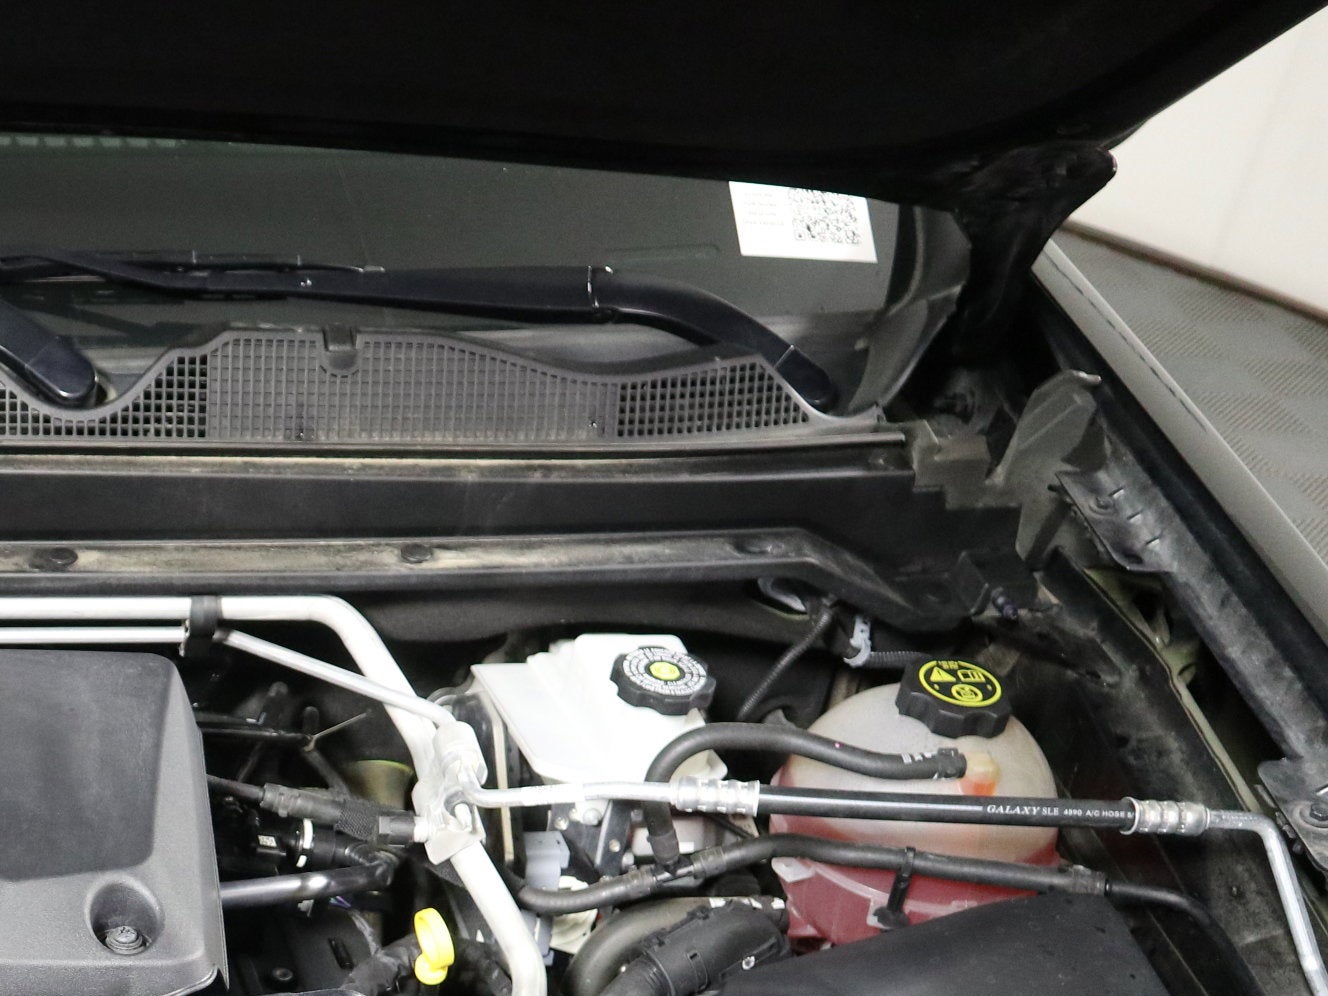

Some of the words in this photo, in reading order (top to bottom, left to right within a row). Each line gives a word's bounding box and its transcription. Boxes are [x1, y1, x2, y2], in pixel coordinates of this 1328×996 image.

[987, 804, 1041, 817] GALAXY
[1042, 806, 1059, 816] SLE
[1102, 810, 1125, 818] HOSE
